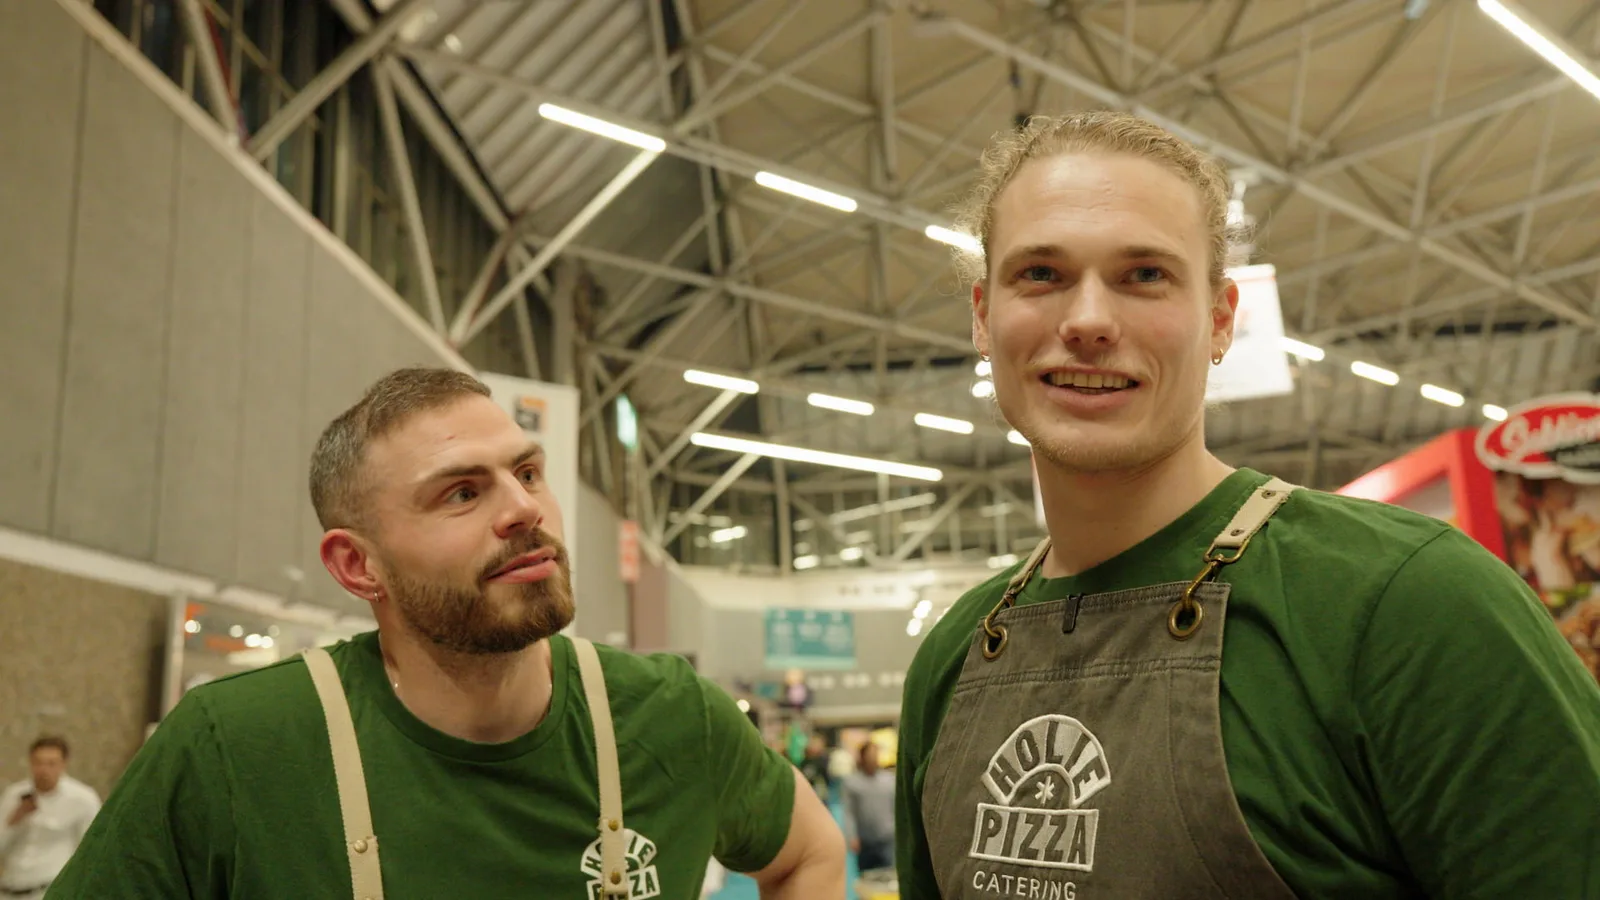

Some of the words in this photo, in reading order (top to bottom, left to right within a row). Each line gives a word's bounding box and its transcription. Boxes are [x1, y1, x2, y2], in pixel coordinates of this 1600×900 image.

[988, 720, 1107, 799] HOLIE
[584, 835, 654, 873] HIE
[975, 809, 1087, 864] PIZZA
[972, 870, 1076, 900] CATERING
